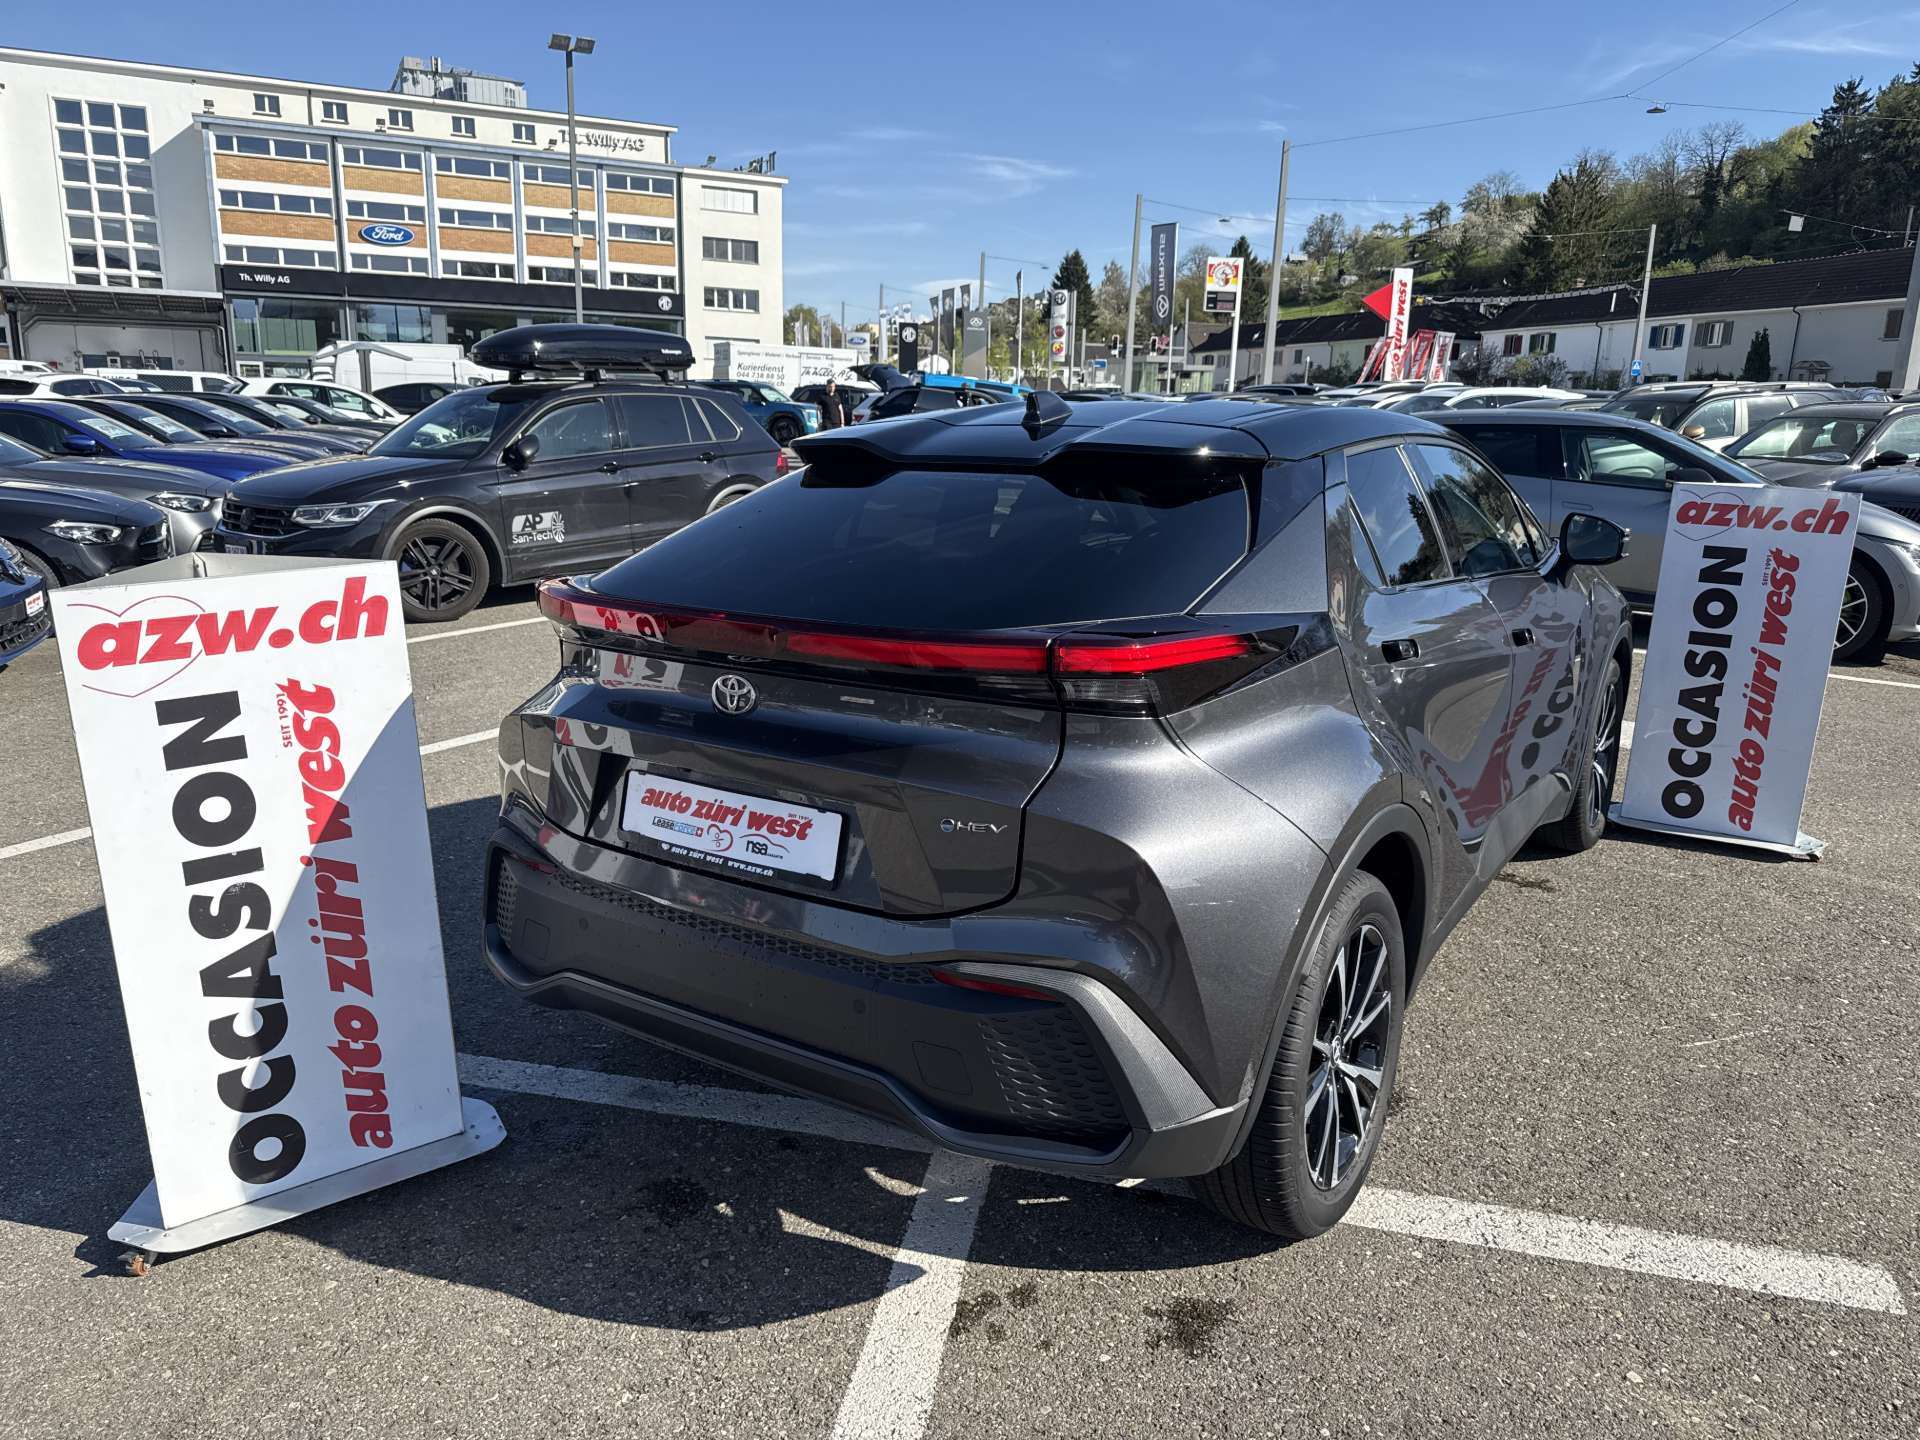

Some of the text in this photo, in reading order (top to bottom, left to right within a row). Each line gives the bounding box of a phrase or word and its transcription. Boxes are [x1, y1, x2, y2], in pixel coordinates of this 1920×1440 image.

[372, 226, 405, 241] Ford
[239, 272, 291, 285] Th. Willy AG
[736, 363, 785, 372] Kurierdienst
[521, 513, 544, 531] AP
[1675, 498, 1850, 535] azw.ch
[512, 530, 554, 544] San-Tech
[77, 576, 389, 671] azw.ch
[1661, 545, 1748, 819] OCCASION
[1728, 547, 1799, 832] auto züri west
[276, 692, 293, 748] SEIT 1991
[641, 788, 813, 841] auto züri west
[957, 820, 1008, 834] HEV
[671, 846, 688, 855] auto
[706, 855, 723, 865] west
[727, 860, 774, 877] www.azw.ch
[746, 840, 768, 855] nsa
[275, 678, 393, 1149] auto züri west
[155, 690, 306, 1184] OCCASION
